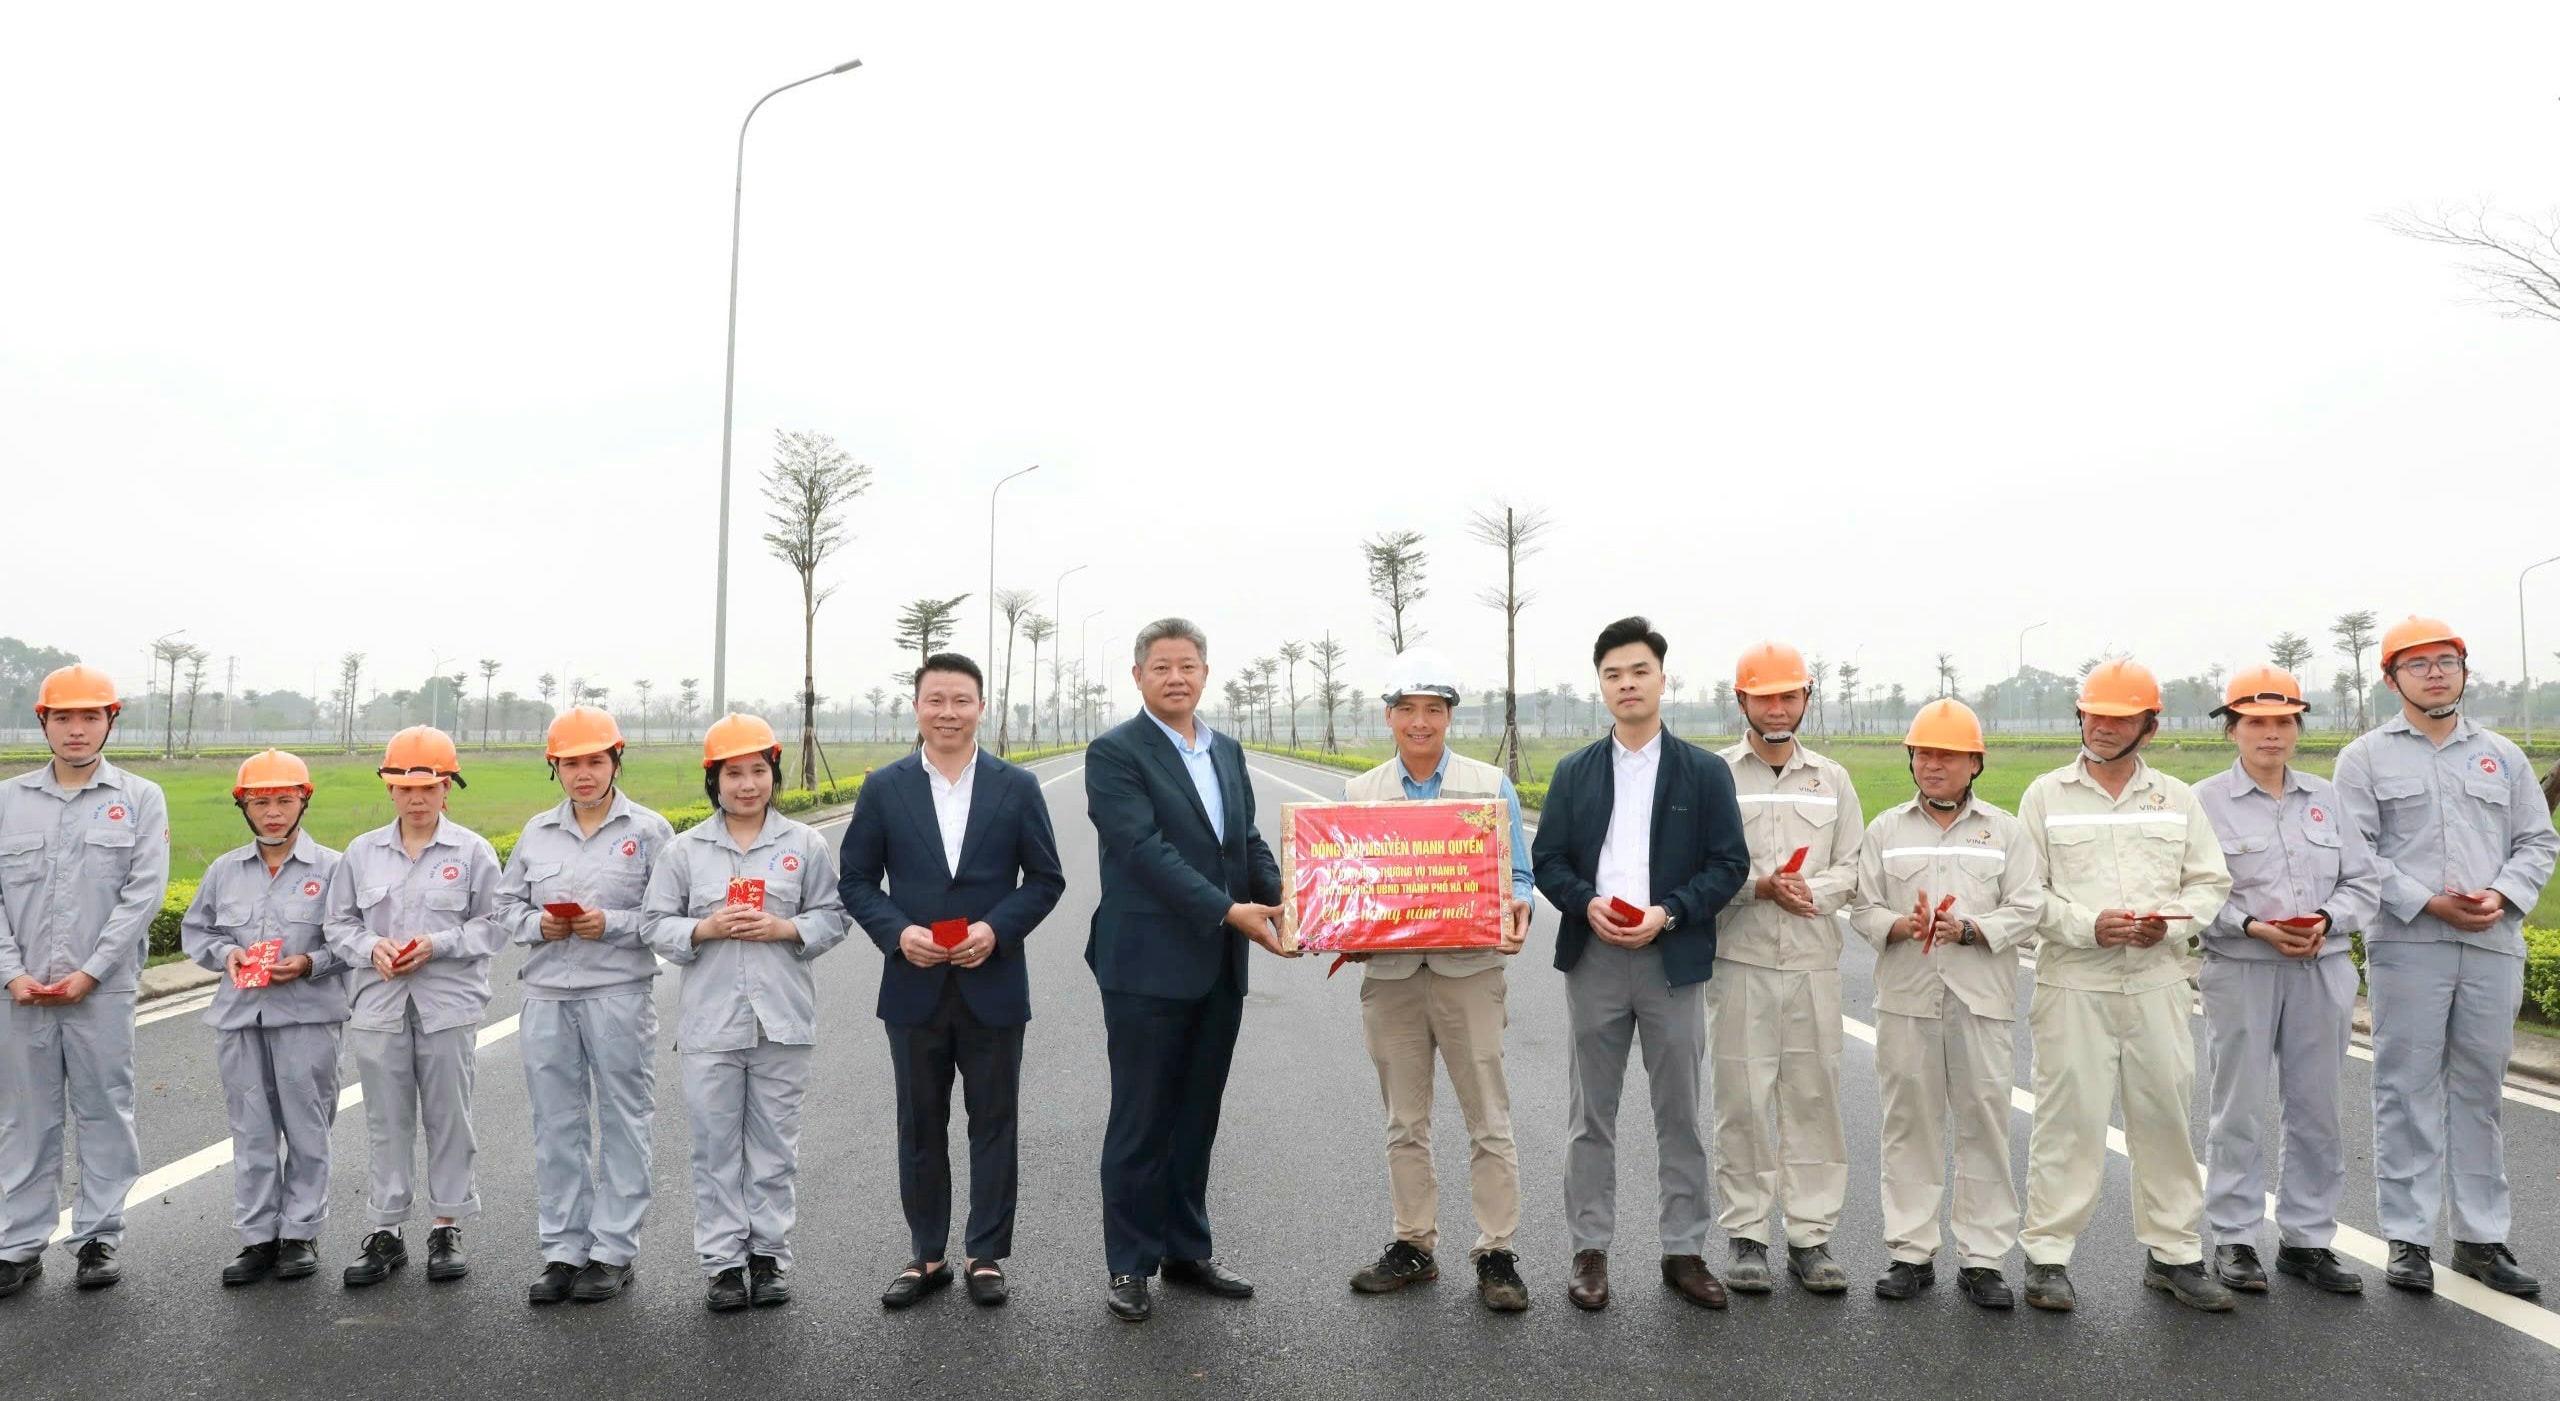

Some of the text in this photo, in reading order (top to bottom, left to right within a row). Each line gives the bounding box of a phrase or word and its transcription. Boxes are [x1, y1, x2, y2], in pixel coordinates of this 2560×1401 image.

[1412, 840, 1446, 858] MẠNH
[1376, 883, 1400, 895] UBND
[1431, 879, 1448, 893] PHỐ
[1463, 880, 1479, 894] NỘI
